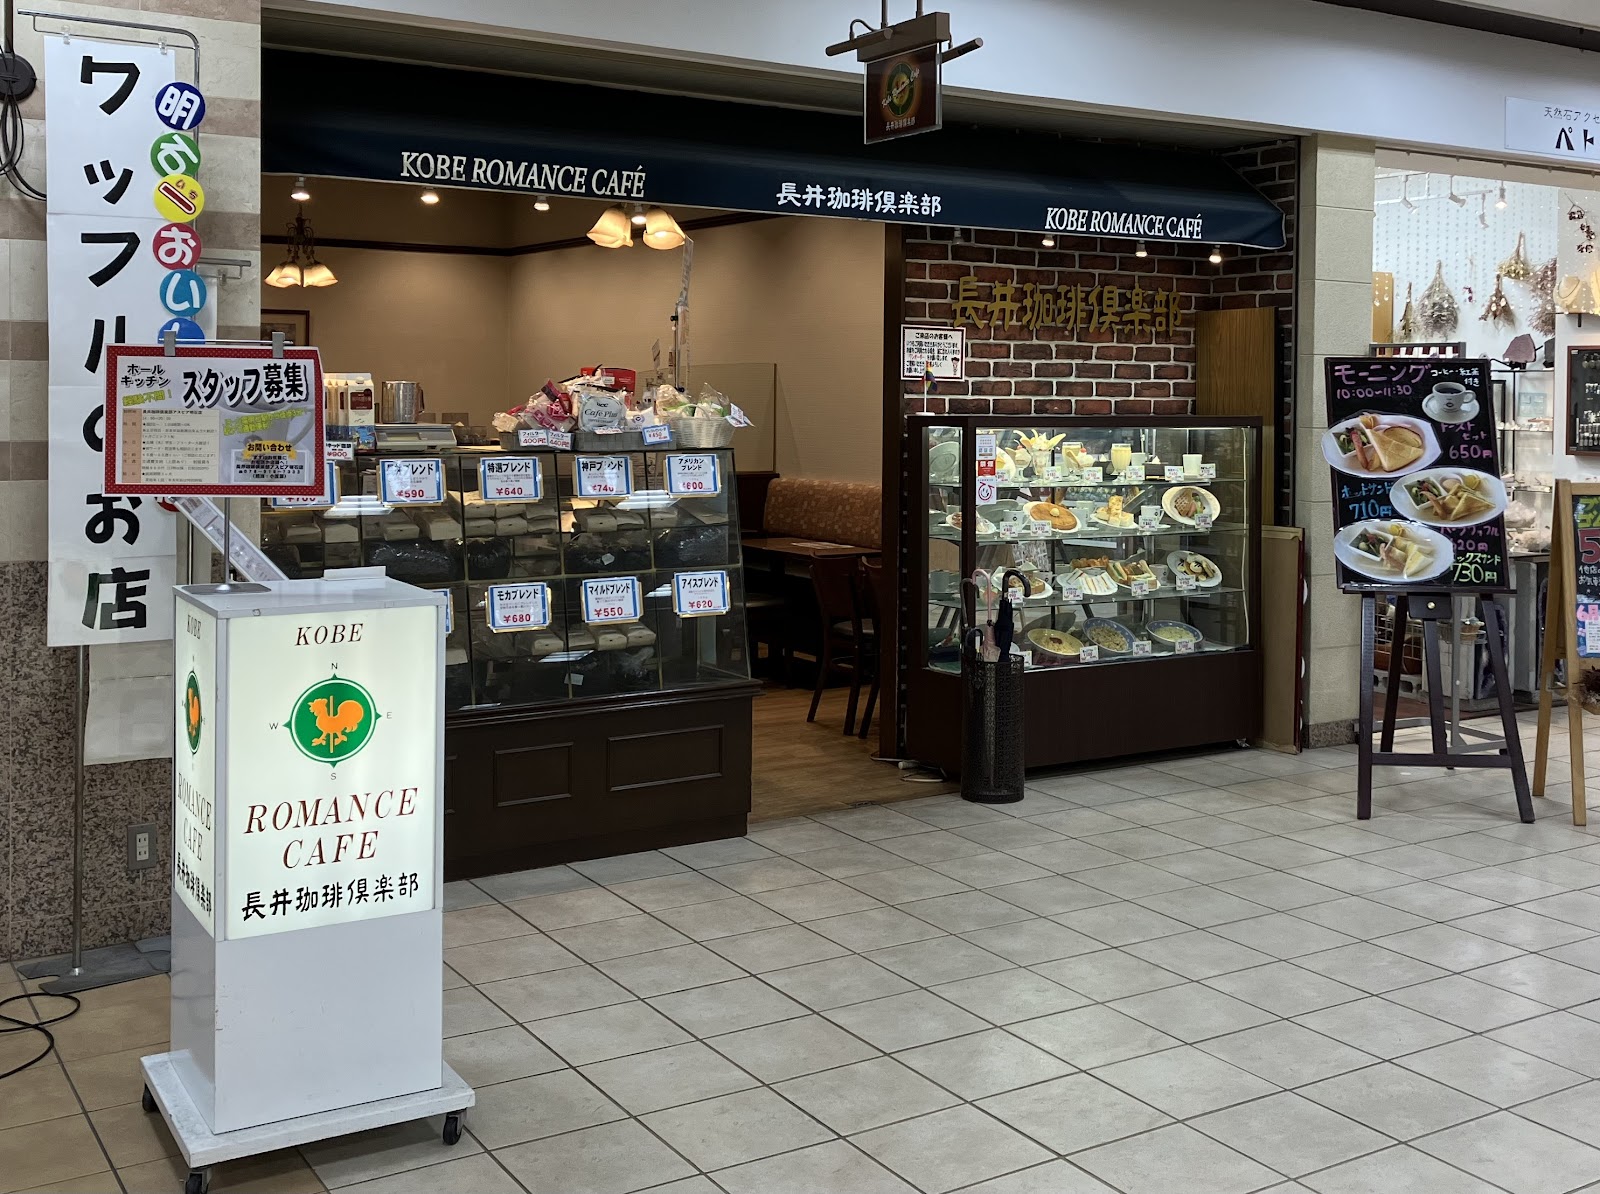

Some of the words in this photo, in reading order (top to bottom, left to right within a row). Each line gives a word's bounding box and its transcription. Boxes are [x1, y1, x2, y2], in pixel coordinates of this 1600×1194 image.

[400, 151, 467, 181] KOBE
[471, 157, 588, 193] ROMANCE
[592, 164, 646, 198] CAFÉ
[776, 182, 942, 217] 長井珈琲倶楽部
[1045, 207, 1088, 232] KOBE
[1090, 210, 1165, 237] ROMANCE
[1166, 213, 1203, 239] CAFÉ
[952, 275, 1182, 337] 長井珈琲倶楽部
[127, 363, 165, 376] ホール
[1334, 363, 1433, 385] モーニング
[1430, 367, 1480, 377] コーヒー・紅茶
[121, 375, 170, 388] キッチン
[182, 362, 308, 407] スタッフ募集
[1464, 378, 1480, 387] 付き
[247, 443, 293, 452] お問い合わせ
[1449, 444, 1493, 460] 650円
[487, 461, 531, 474] 特選ブレンド
[495, 487, 523, 496] ¥640
[682, 481, 704, 490] ¥600
[395, 489, 425, 498] ¥590
[1349, 499, 1393, 520] 710円
[1455, 552, 1501, 566] ックスサンド
[1449, 562, 1498, 584] 730円
[588, 582, 631, 596] マイルドブレンド
[681, 576, 719, 589] アイスブレンド
[497, 588, 539, 601] モカブレンド
[687, 599, 713, 609] ¥620
[503, 613, 531, 623] ¥680
[593, 606, 624, 618] ¥550
[186, 613, 202, 640] KOBE
[294, 623, 364, 647] KOBE
[331, 662, 338, 670] N
[386, 712, 393, 720] E
[269, 722, 279, 730] W
[330, 772, 337, 780] S
[177, 772, 212, 832] ROMANCE
[244, 787, 419, 834] ROMANCE
[183, 817, 203, 862] CAFE
[282, 830, 379, 869] CAFE
[241, 872, 419, 921] 長井珈琲倶楽部
